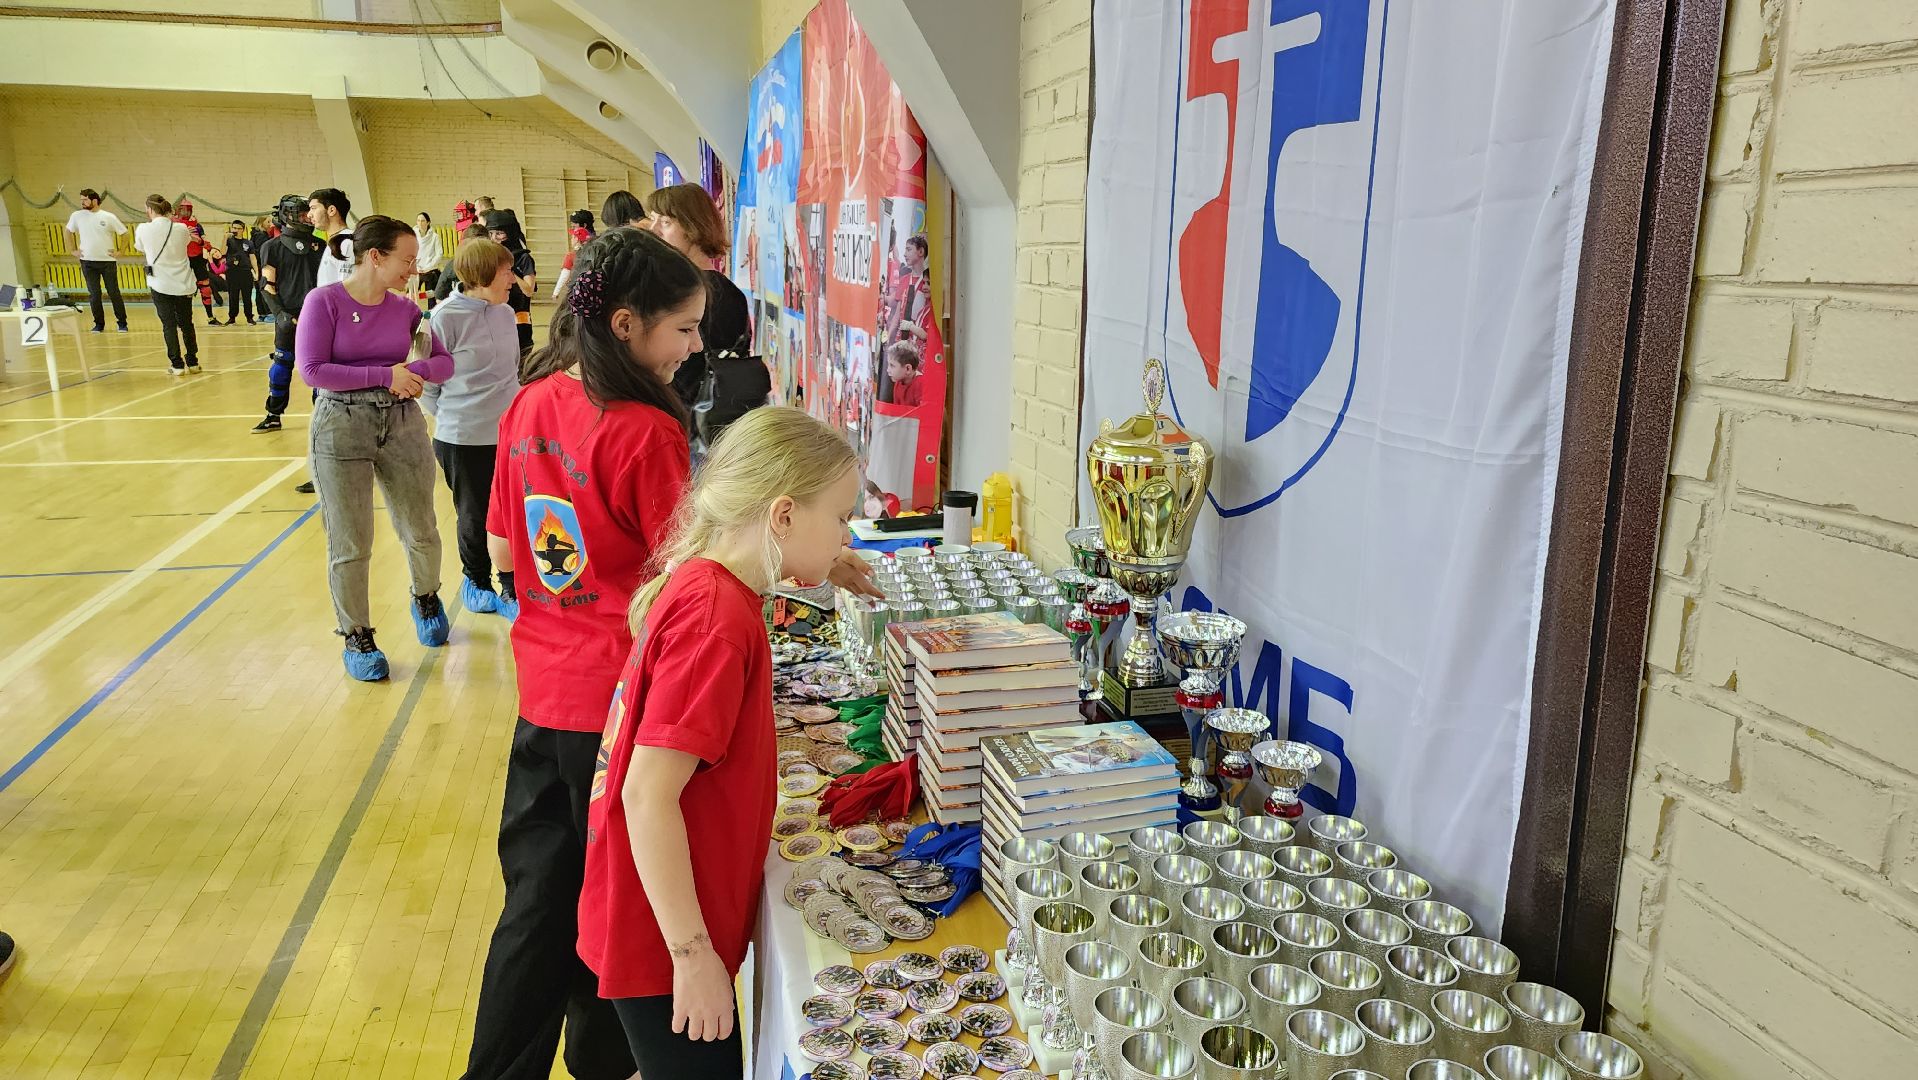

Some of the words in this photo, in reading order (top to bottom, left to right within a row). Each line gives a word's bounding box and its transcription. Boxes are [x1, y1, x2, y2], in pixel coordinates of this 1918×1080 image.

[24, 316, 45, 343] 2
[510, 436, 589, 488] КУЗНЦА
[1014, 746, 1034, 765] ЧЕСТЬ
